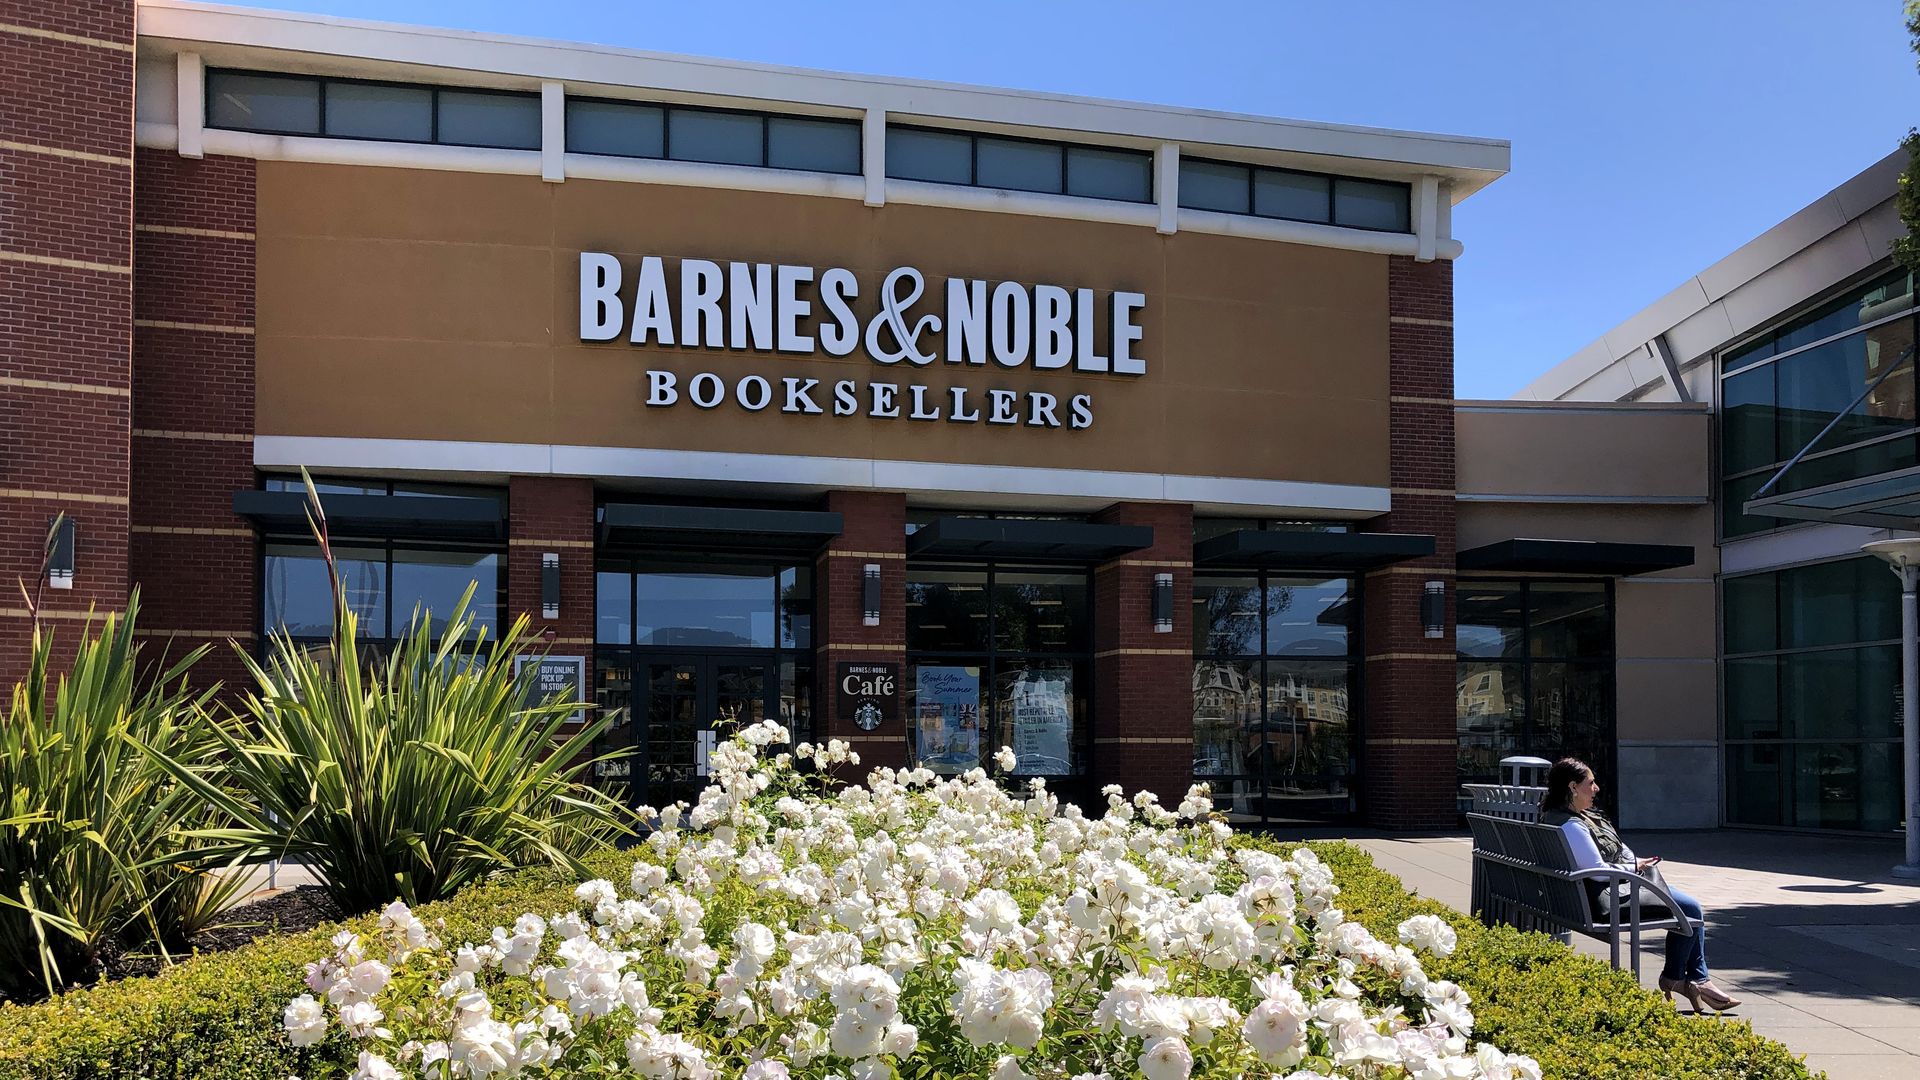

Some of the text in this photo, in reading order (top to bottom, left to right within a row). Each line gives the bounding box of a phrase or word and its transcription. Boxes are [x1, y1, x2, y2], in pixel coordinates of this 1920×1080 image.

[580, 252, 1146, 374] BARNES & NOBLE
[646, 370, 1094, 429] BOOKSELLERS
[541, 666, 575, 674] BUY ONLINE
[921, 671, 963, 685] Book Your
[842, 674, 894, 696] Café
[934, 681, 973, 695] Summer
